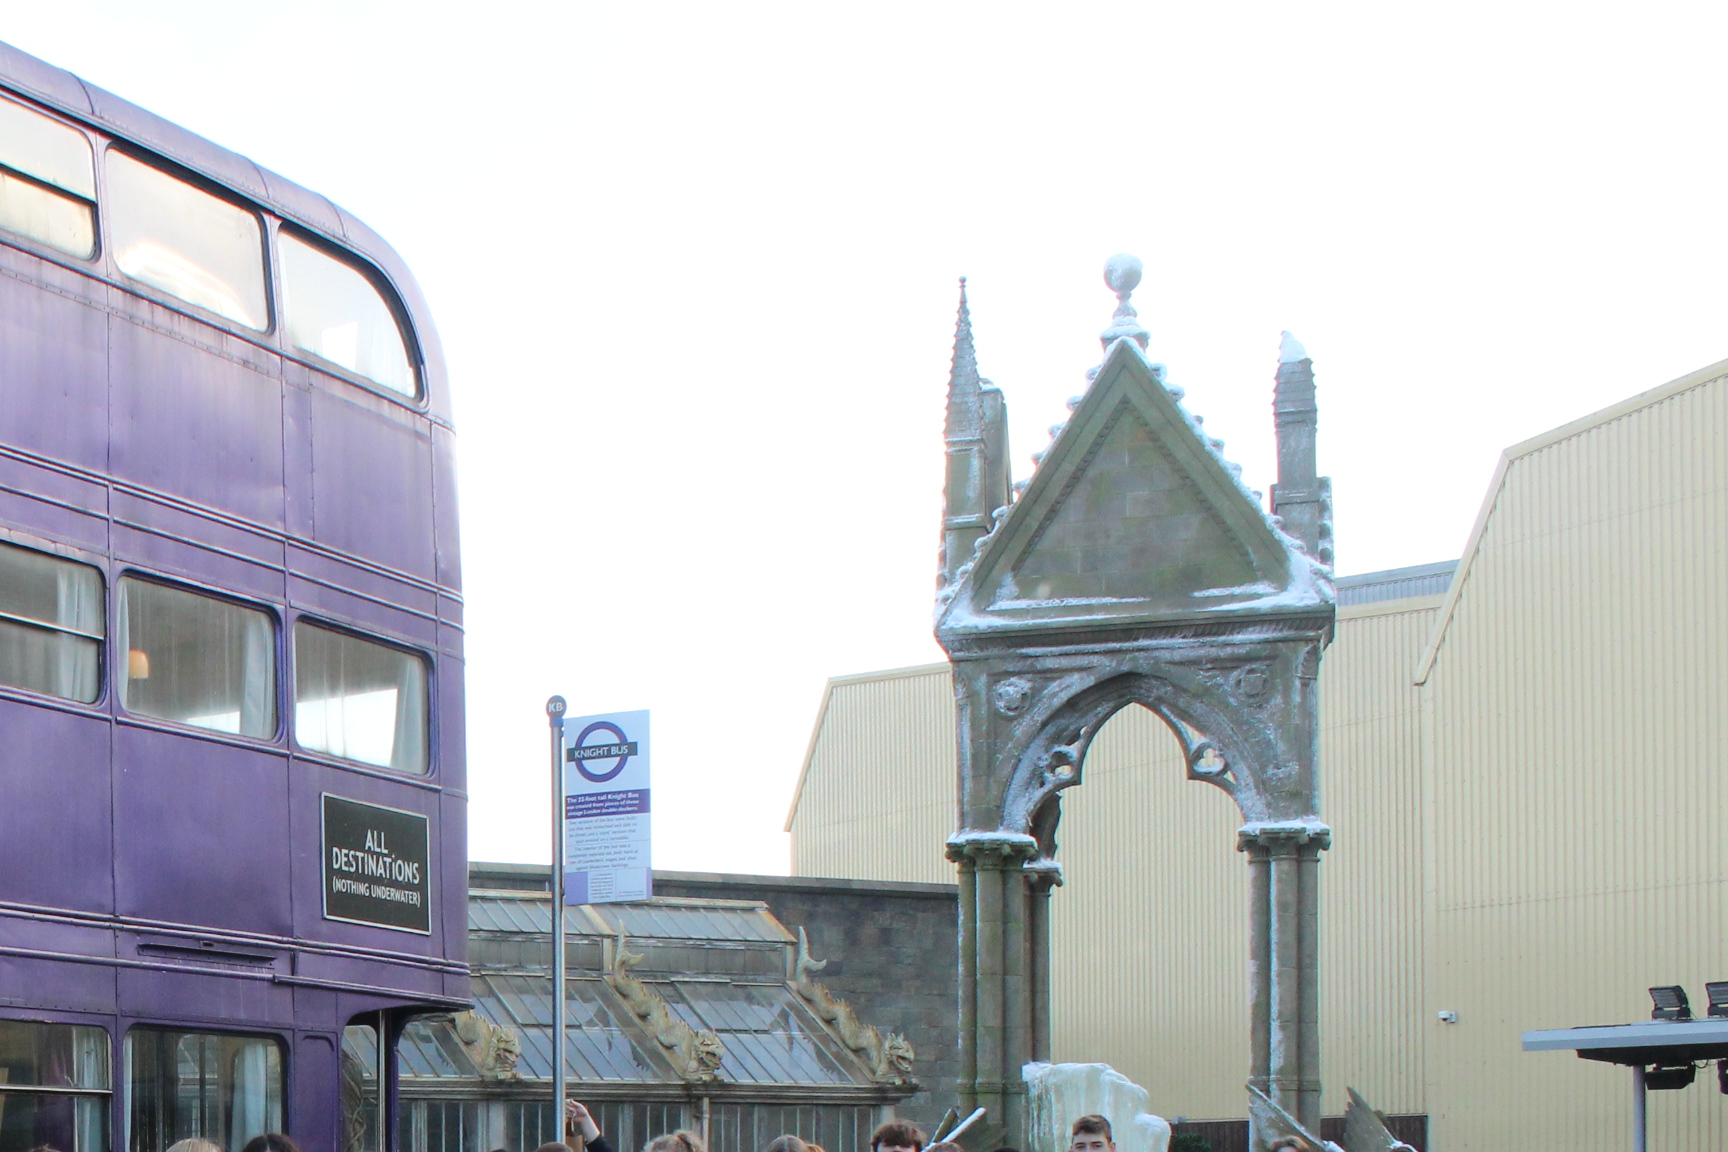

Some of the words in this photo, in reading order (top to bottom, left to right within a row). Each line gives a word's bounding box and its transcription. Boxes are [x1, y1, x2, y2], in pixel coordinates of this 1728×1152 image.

[548, 702, 563, 712] KB
[574, 747, 610, 758] KNIGHT
[610, 745, 628, 755] BUS
[365, 829, 388, 854] ALL
[332, 847, 420, 884] DESTINATIONS
[332, 876, 369, 896] (NOTHING
[371, 884, 421, 907] UNDERWATER)
